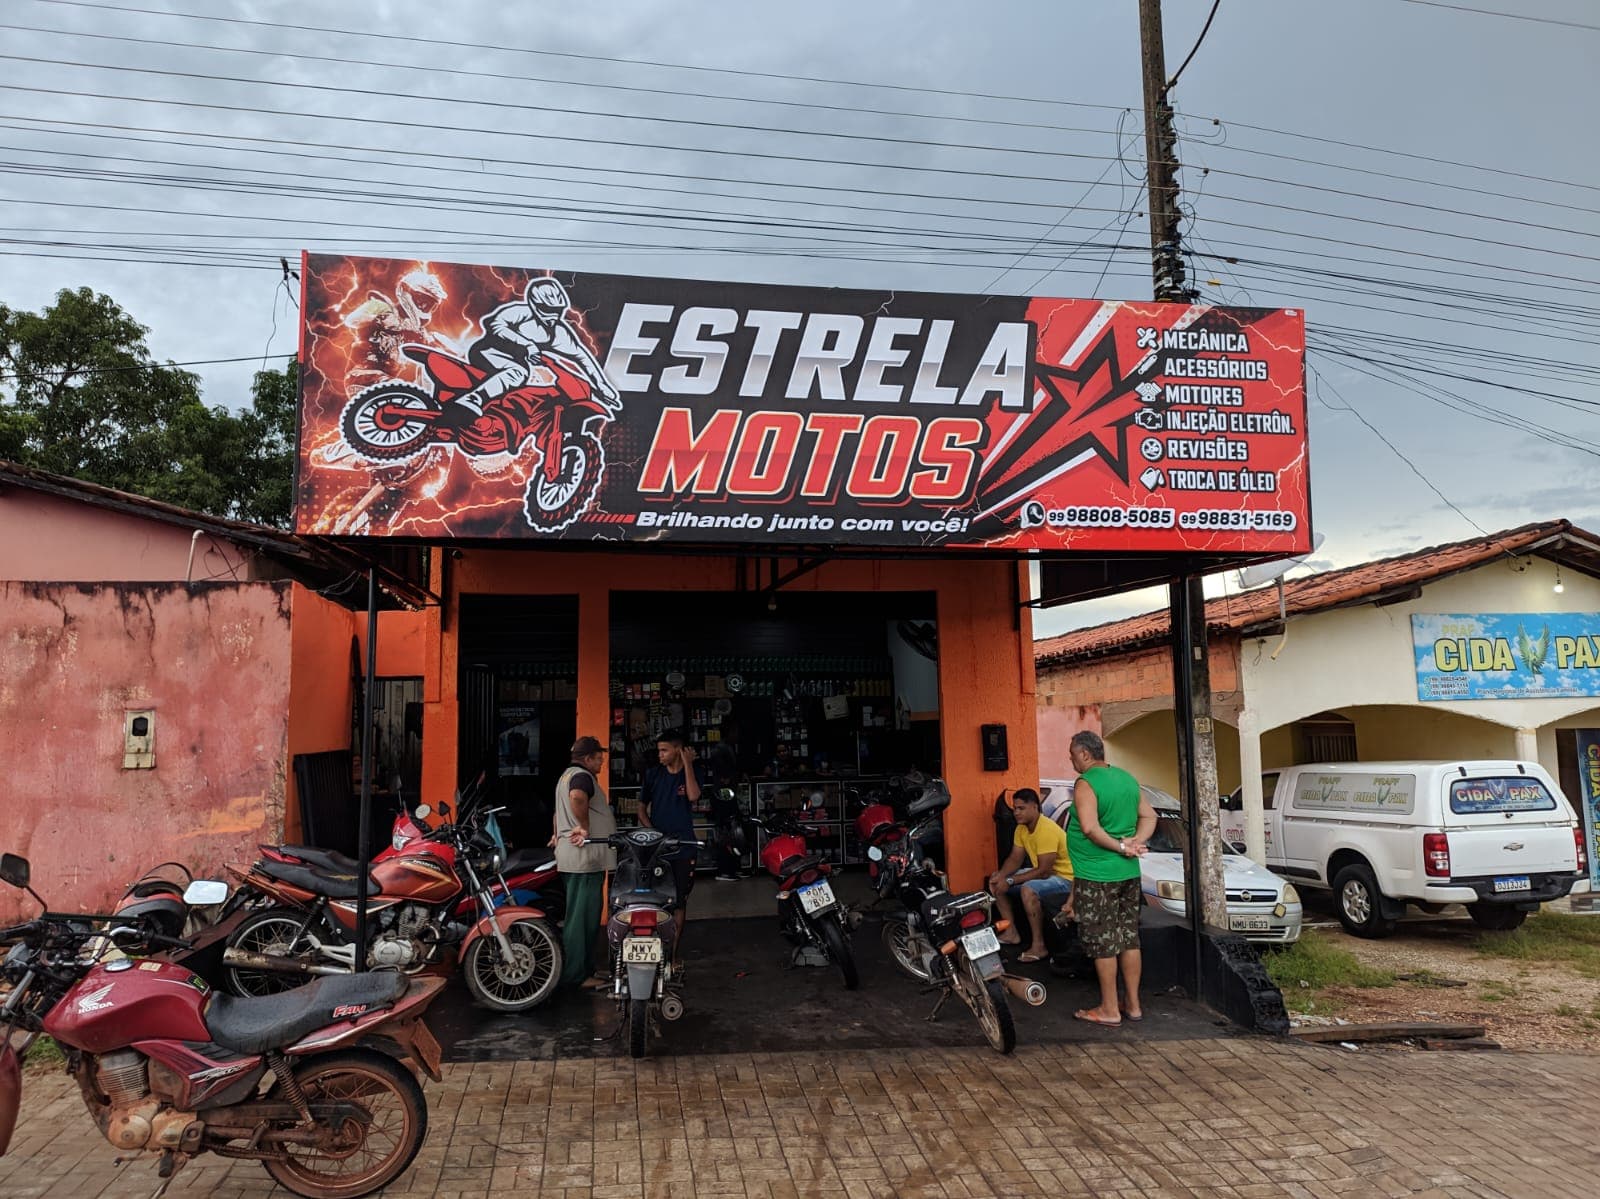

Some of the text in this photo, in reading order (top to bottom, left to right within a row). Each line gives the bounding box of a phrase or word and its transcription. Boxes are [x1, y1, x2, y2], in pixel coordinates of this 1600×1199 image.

[1164, 328, 1249, 352] MECÂNICA
[603, 302, 1029, 407] ESTRELA
[1164, 356, 1267, 379] ACESSÓRIOS
[1166, 385, 1243, 406] MOTORES
[1167, 409, 1295, 434] INJEÇÃO ELETRÔN.
[637, 406, 983, 500] MOTOS
[1168, 437, 1248, 460] REVISÕES
[1169, 469, 1275, 492] TROCA DE ÓLEO
[636, 511, 970, 533] Brilhando junto com você!
[1434, 638, 1517, 672] CIDA
[1456, 786, 1542, 802] CIDA PAX
[78, 1001, 115, 1014] HONDA
